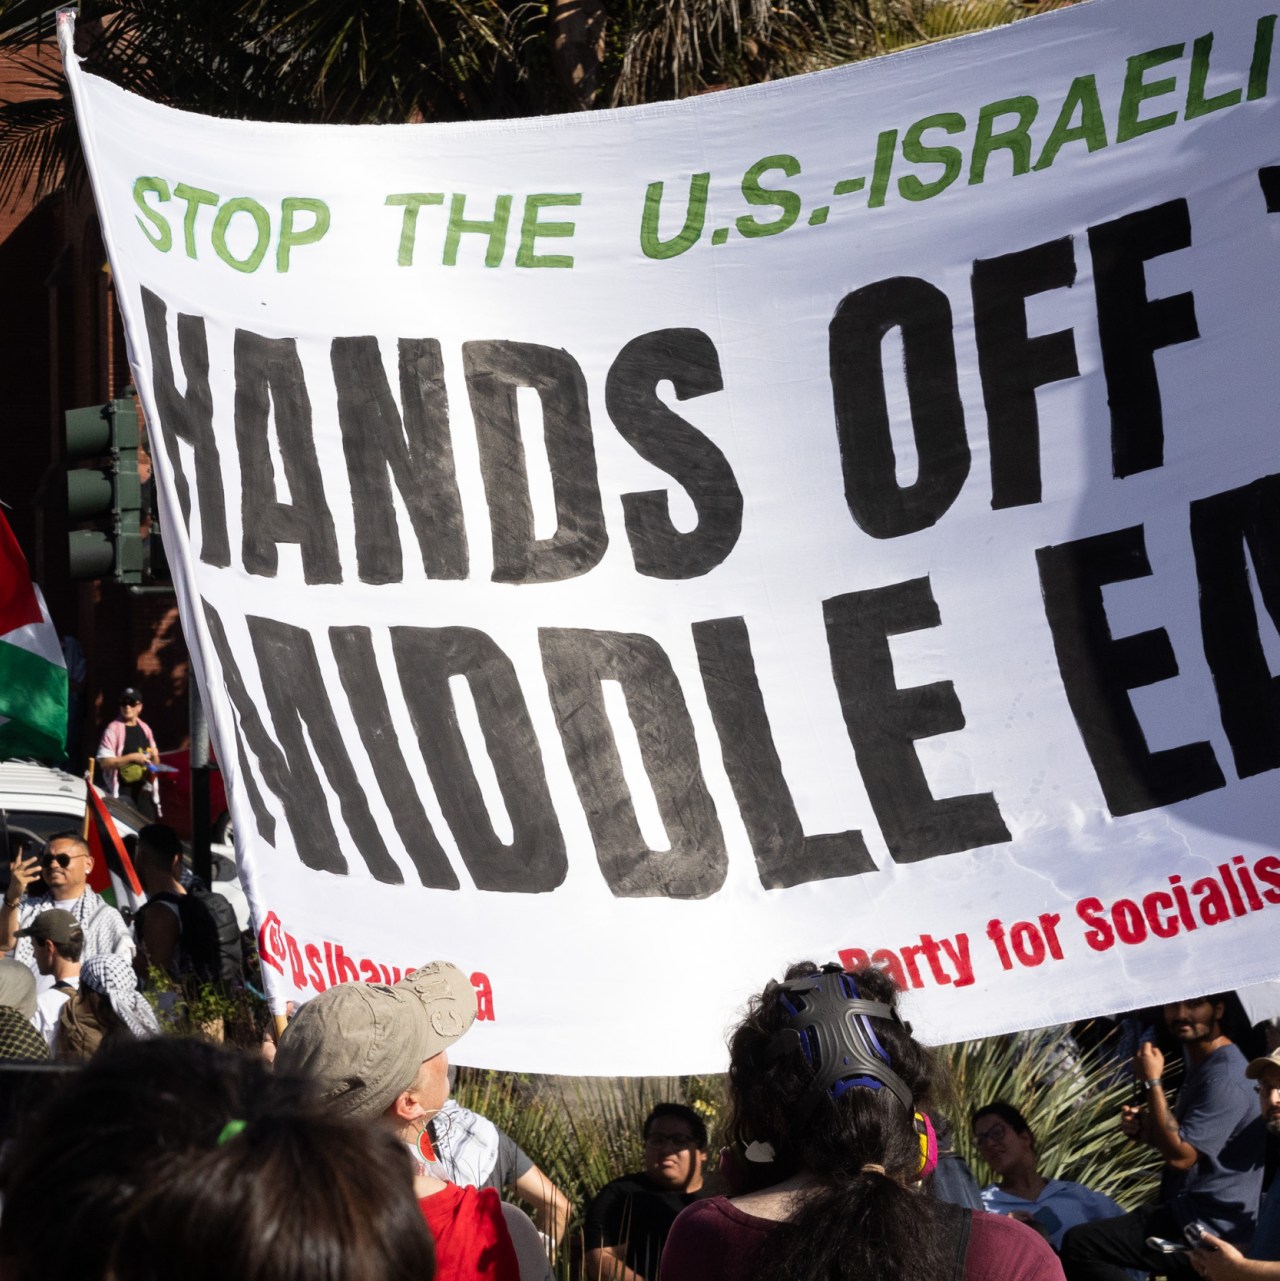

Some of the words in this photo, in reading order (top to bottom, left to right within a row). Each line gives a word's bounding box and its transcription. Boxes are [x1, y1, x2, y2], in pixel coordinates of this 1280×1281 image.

[132, 176, 331, 273] STOP
[384, 192, 582, 268] THE
[639, 14, 1278, 260] U.S.-ISRAELI
[140, 283, 744, 586] HANDS
[829, 198, 1201, 539] OFF
[200, 574, 1012, 900] MIDDLE
[986, 911, 1064, 971] for
